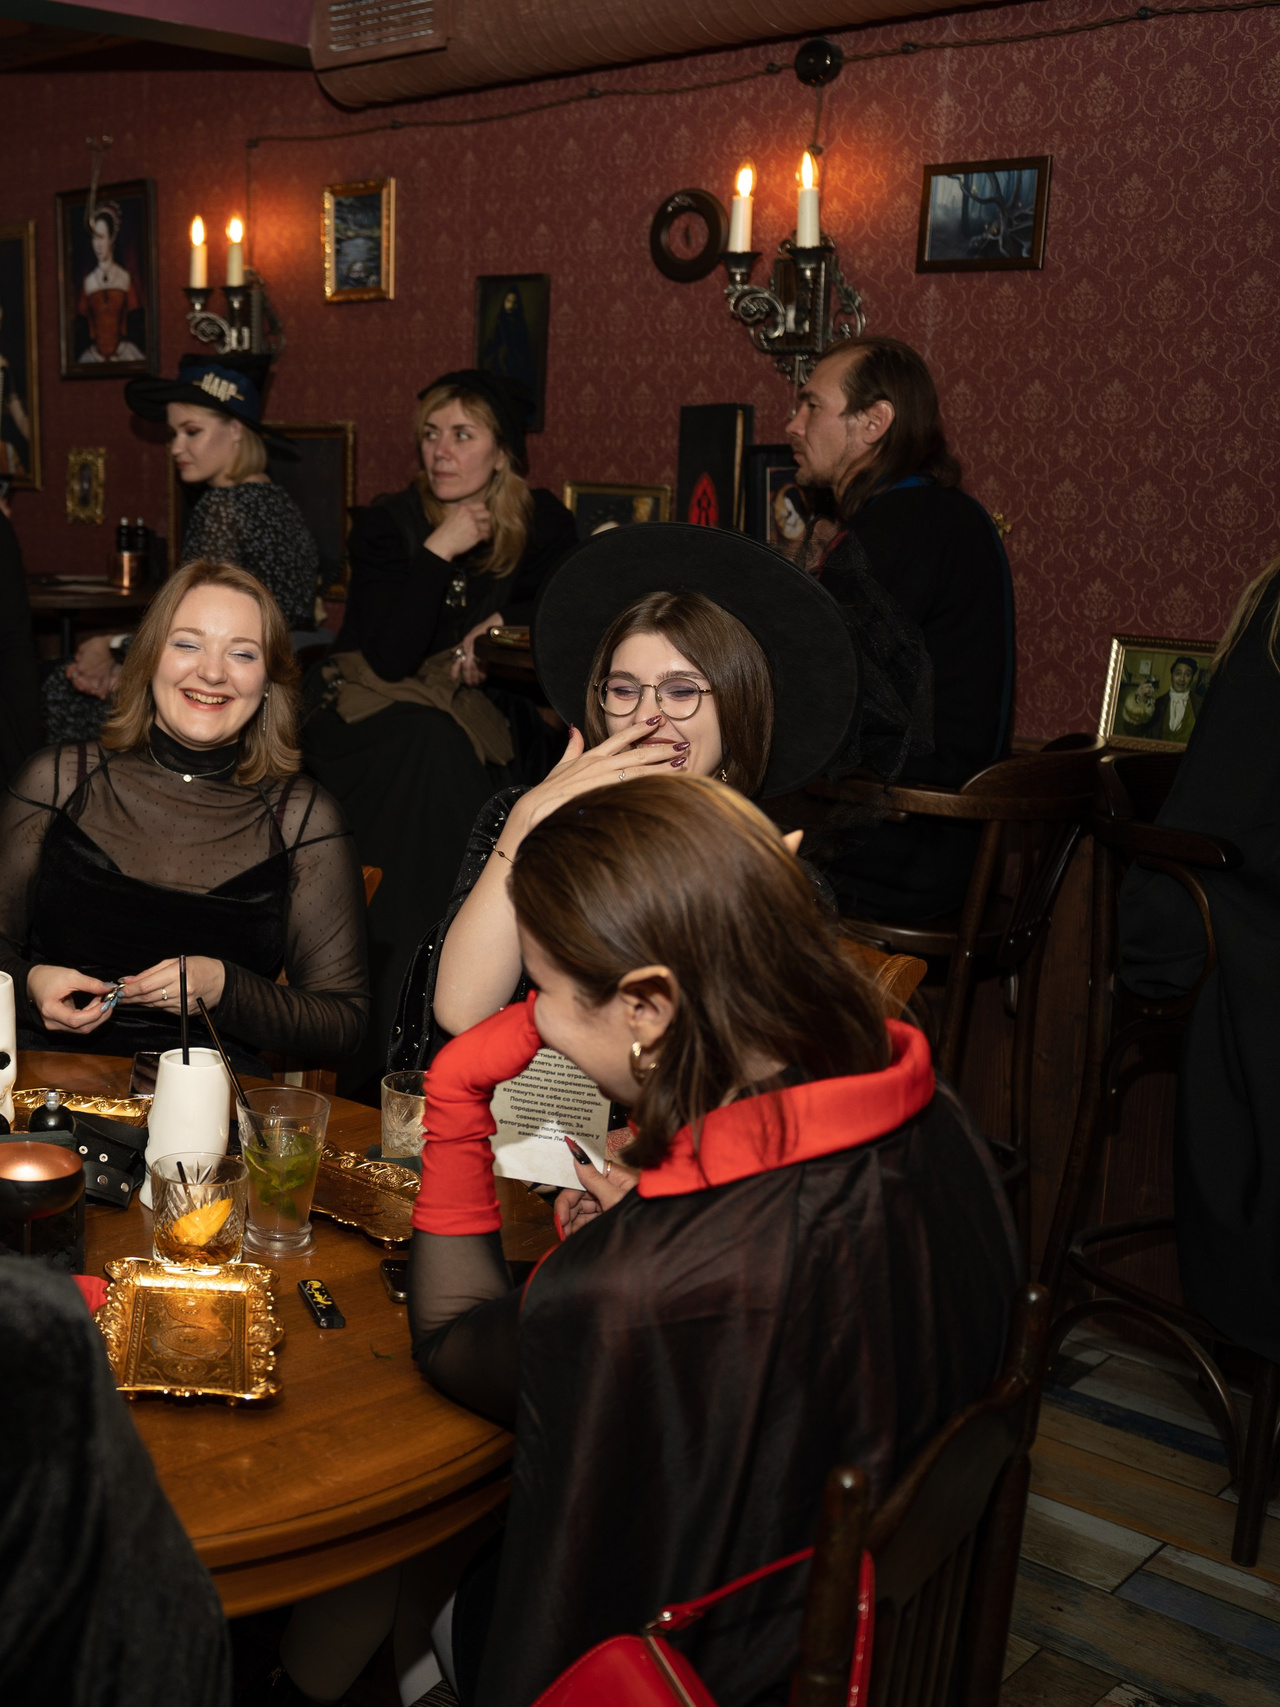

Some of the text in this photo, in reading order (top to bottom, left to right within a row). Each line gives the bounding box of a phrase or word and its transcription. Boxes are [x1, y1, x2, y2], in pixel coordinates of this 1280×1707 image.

[510, 1081, 548, 1090] технологии
[550, 1087, 585, 1096] позволяют
[503, 1088, 535, 1097] взглянуть
[572, 1098, 602, 1106] стороны.
[510, 1096, 538, 1105] Попроси
[556, 1105, 593, 1113] клыкастых
[511, 1105, 546, 1114] сородичей
[547, 1111, 581, 1120] собраться
[499, 1119, 539, 1130] фотографию
[541, 1126, 575, 1136] получишь
[516, 1114, 554, 1123] совместное
[556, 1119, 573, 1127] фото.
[518, 1130, 552, 1140] вампирши
